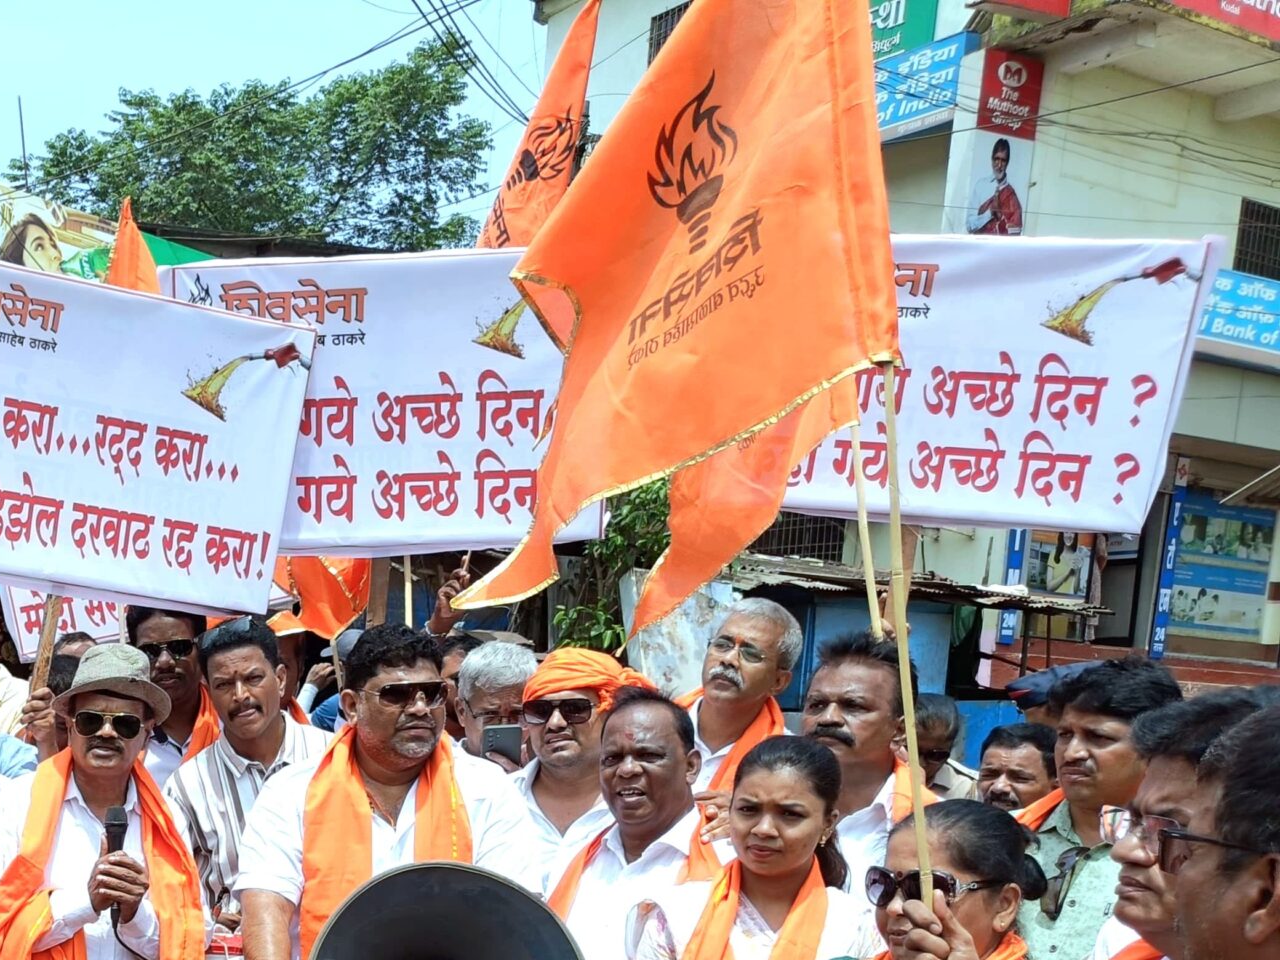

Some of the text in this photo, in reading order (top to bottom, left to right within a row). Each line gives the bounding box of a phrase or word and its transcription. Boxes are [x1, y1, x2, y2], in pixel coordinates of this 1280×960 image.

[986, 96, 1030, 118] Muthoot
[1000, 86, 1019, 101] The
[220, 279, 368, 325] शिवसेना
[29, 336, 58, 353] ठाकरे
[331, 330, 366, 347] ठाकरे
[1211, 317, 1257, 341] Bank
[1260, 330, 1280, 346] of
[923, 351, 1021, 419] अच्छे
[1029, 353, 1109, 431] दिन
[1129, 374, 1158, 428] ?
[300, 369, 544, 447] गये अच्छे दिन
[908, 428, 1006, 494] अच्छे
[1014, 430, 1091, 507] दिन
[1112, 452, 1141, 505] ?
[296, 448, 538, 525] गये अच्छे दिन
[71, 501, 156, 561] दरवाढ
[161, 517, 198, 577] रद्द
[205, 524, 271, 581] करा!
[1002, 613, 1016, 627] 24
[1154, 626, 1165, 641] 24
